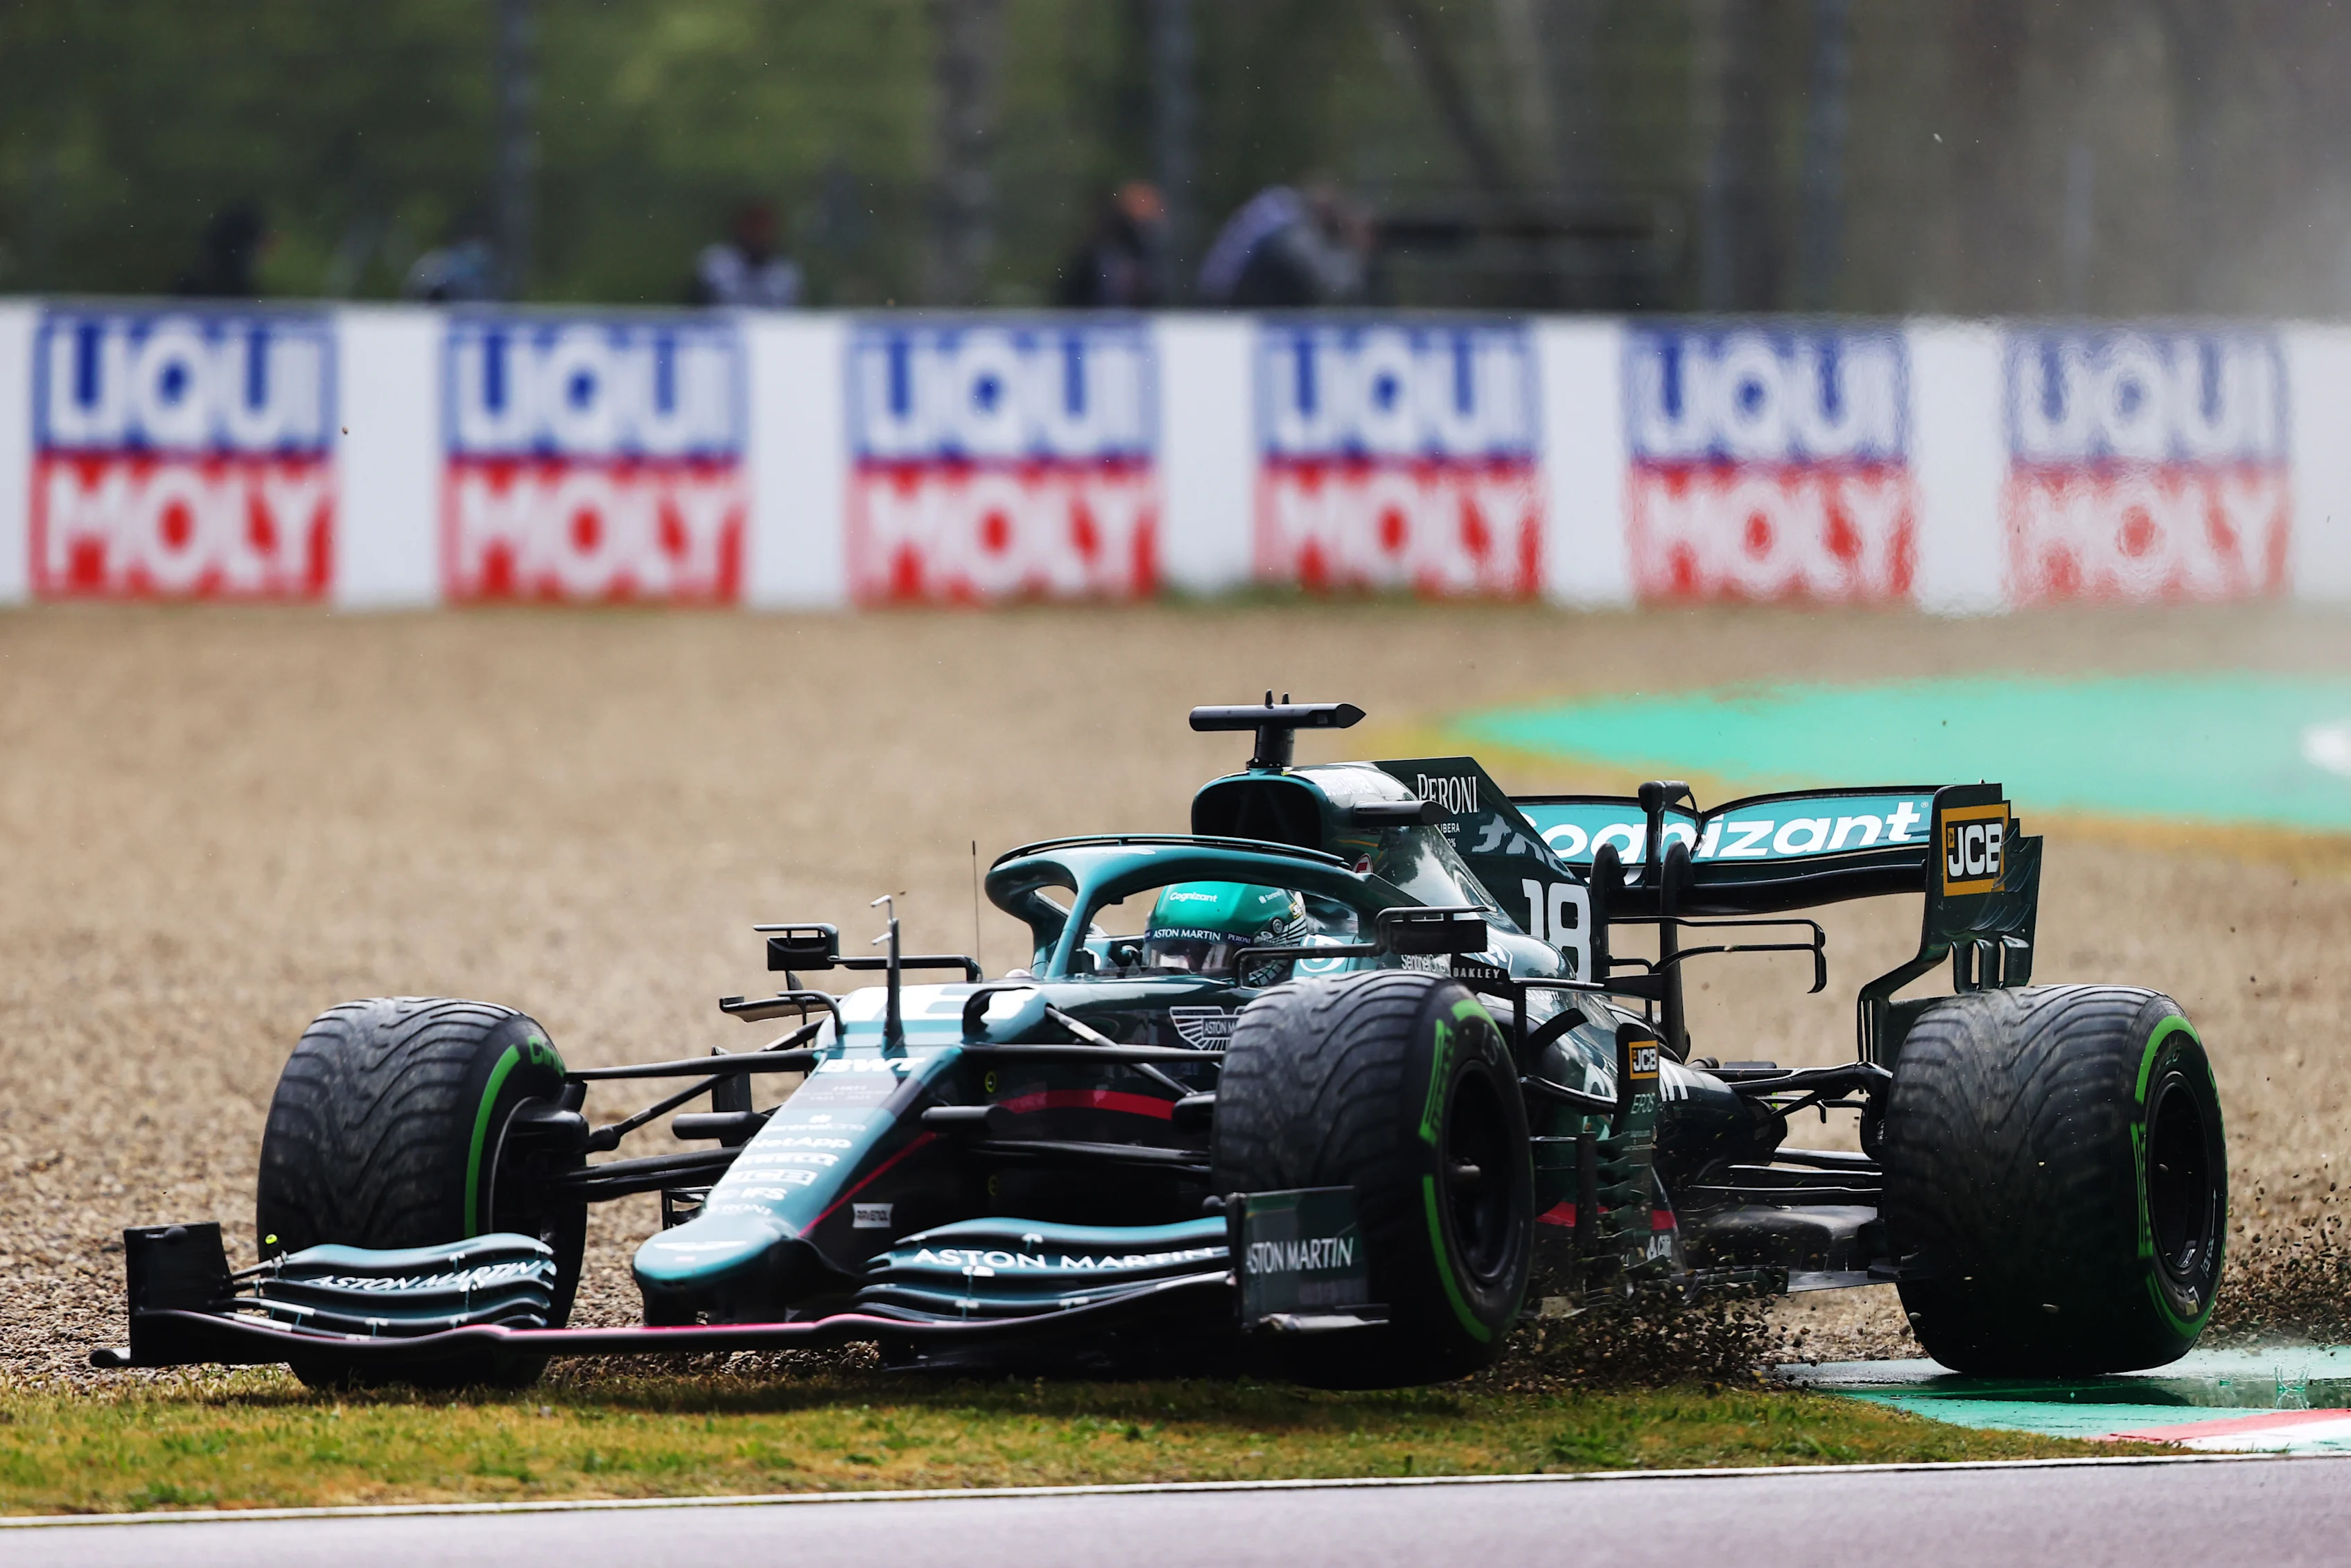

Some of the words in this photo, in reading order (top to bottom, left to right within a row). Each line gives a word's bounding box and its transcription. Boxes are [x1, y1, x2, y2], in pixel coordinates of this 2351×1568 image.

[50, 323, 322, 443] LIQUI
[458, 330, 733, 449] LIQUI
[863, 331, 1139, 449] LIQUI
[1273, 333, 1521, 449] LIQUI
[1642, 335, 1896, 452] LIQUI
[2022, 338, 2271, 453] LIQUI
[50, 463, 329, 586] MOLY
[458, 470, 740, 589] MOLY
[866, 472, 1151, 589] MOLY
[1273, 472, 1532, 588] MOLY
[1644, 476, 1906, 590] MOLY
[2025, 474, 2283, 592] MOLY
[1417, 773, 1478, 815] PERONI
[1440, 822, 1460, 834] IBERA
[1948, 823, 2003, 877] JCB
[1170, 892, 1218, 902] Cognizant
[1153, 928, 1179, 939] ASTON
[1181, 929, 1221, 941] MARTIN
[1227, 933, 1251, 944] PERONI
[1521, 878, 1591, 983] 18
[1453, 967, 1500, 979] OAKLEY
[1205, 1021, 1227, 1034] ASTON
[818, 1057, 927, 1073] BWT
[1633, 1048, 1657, 1072] JCB
[1631, 1092, 1656, 1114] EPOS
[746, 1136, 853, 1149] NetApp
[304, 1275, 421, 1291] ASTON
[417, 1260, 541, 1290] MARTIN
[913, 1249, 1046, 1269] ASTON
[1060, 1247, 1214, 1269] MARTIN
[1246, 1241, 1284, 1274] ASTON
[1286, 1237, 1354, 1270] MARTIN
